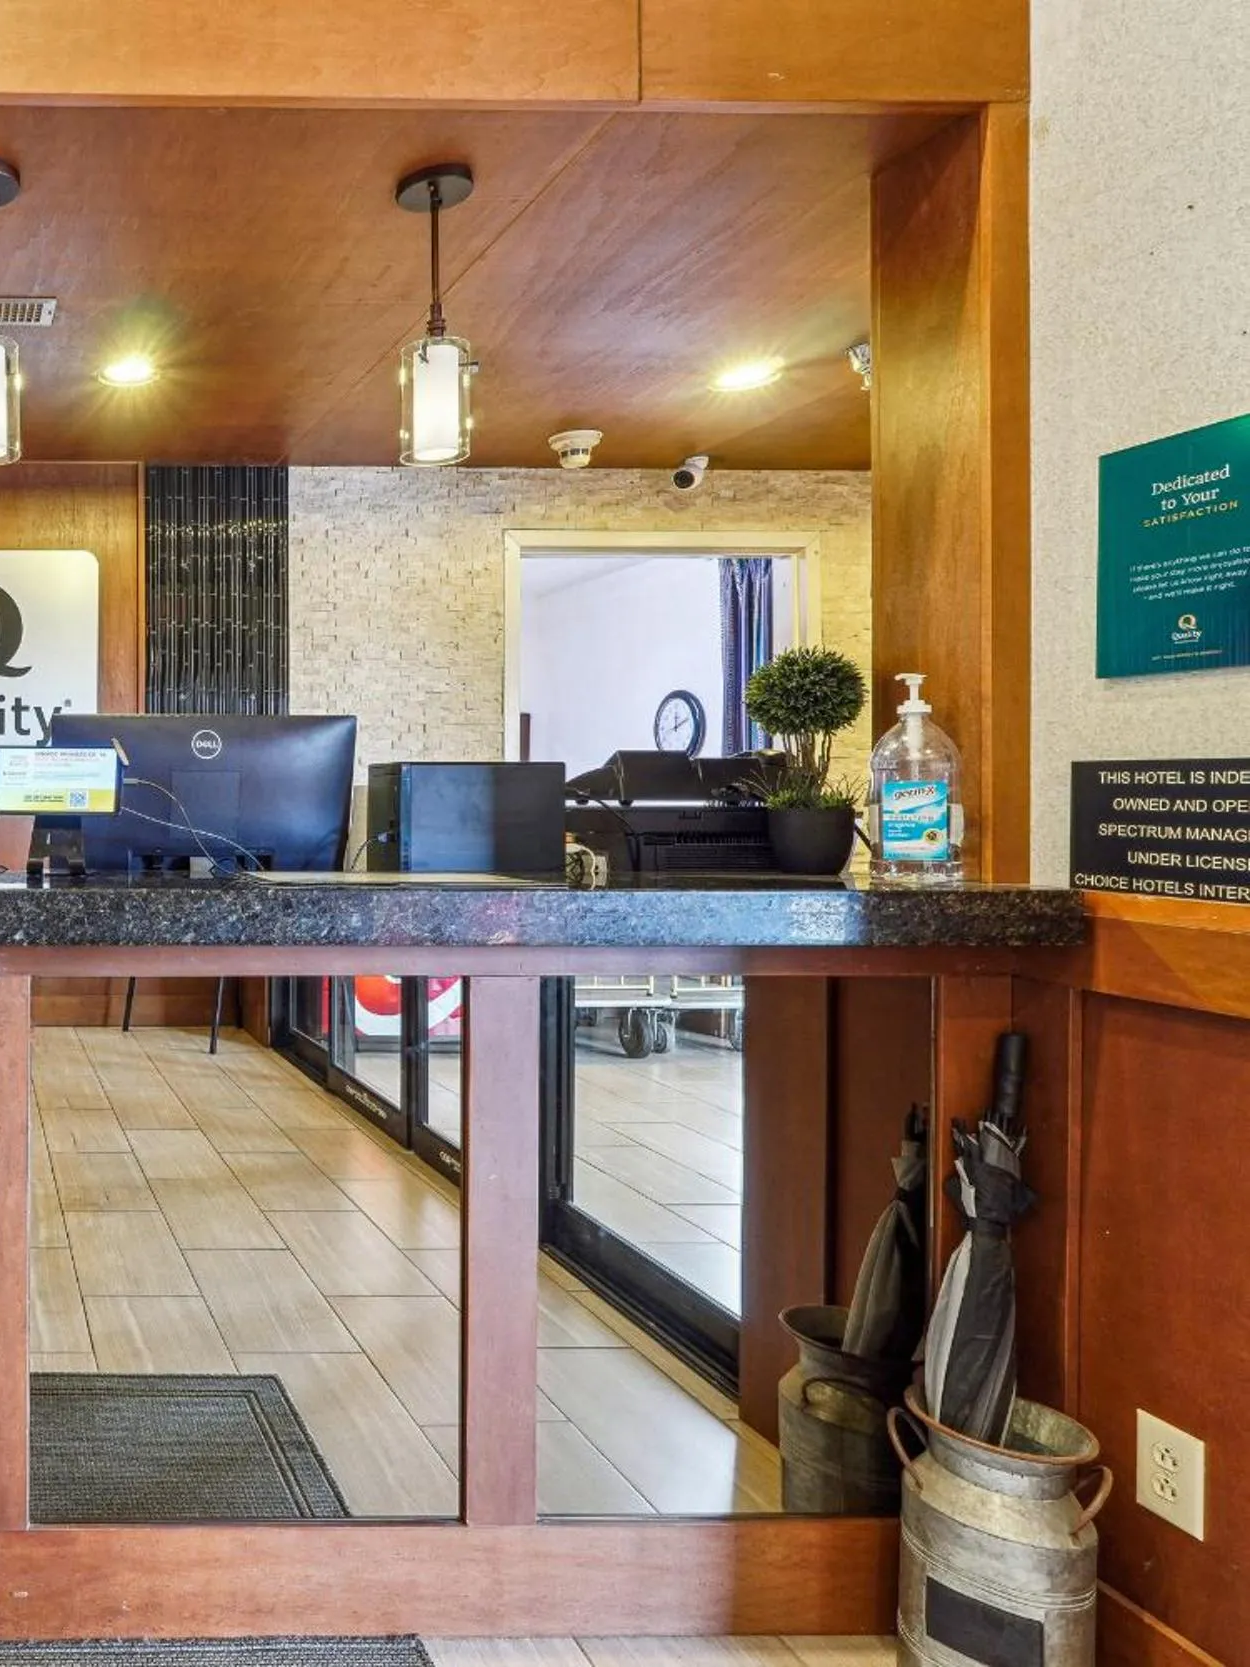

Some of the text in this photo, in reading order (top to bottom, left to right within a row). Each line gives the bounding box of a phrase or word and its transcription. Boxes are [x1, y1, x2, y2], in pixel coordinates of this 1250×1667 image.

[1151, 464, 1231, 496] Dedicated
[1161, 488, 1220, 511] to Your
[1142, 500, 1239, 528] SATISFACTION
[1171, 630, 1203, 641] Quality
[196, 740, 218, 749] DELL
[1098, 771, 1250, 784] THIS HOTEL IS INDE
[1113, 798, 1170, 811] OWNED
[1173, 799, 1207, 812] AND
[1098, 823, 1250, 843] SPECTRUM MANAG
[1127, 851, 1250, 872] UNDER LICENS
[1074, 873, 1250, 900] CHOICE HOTELS INTER
